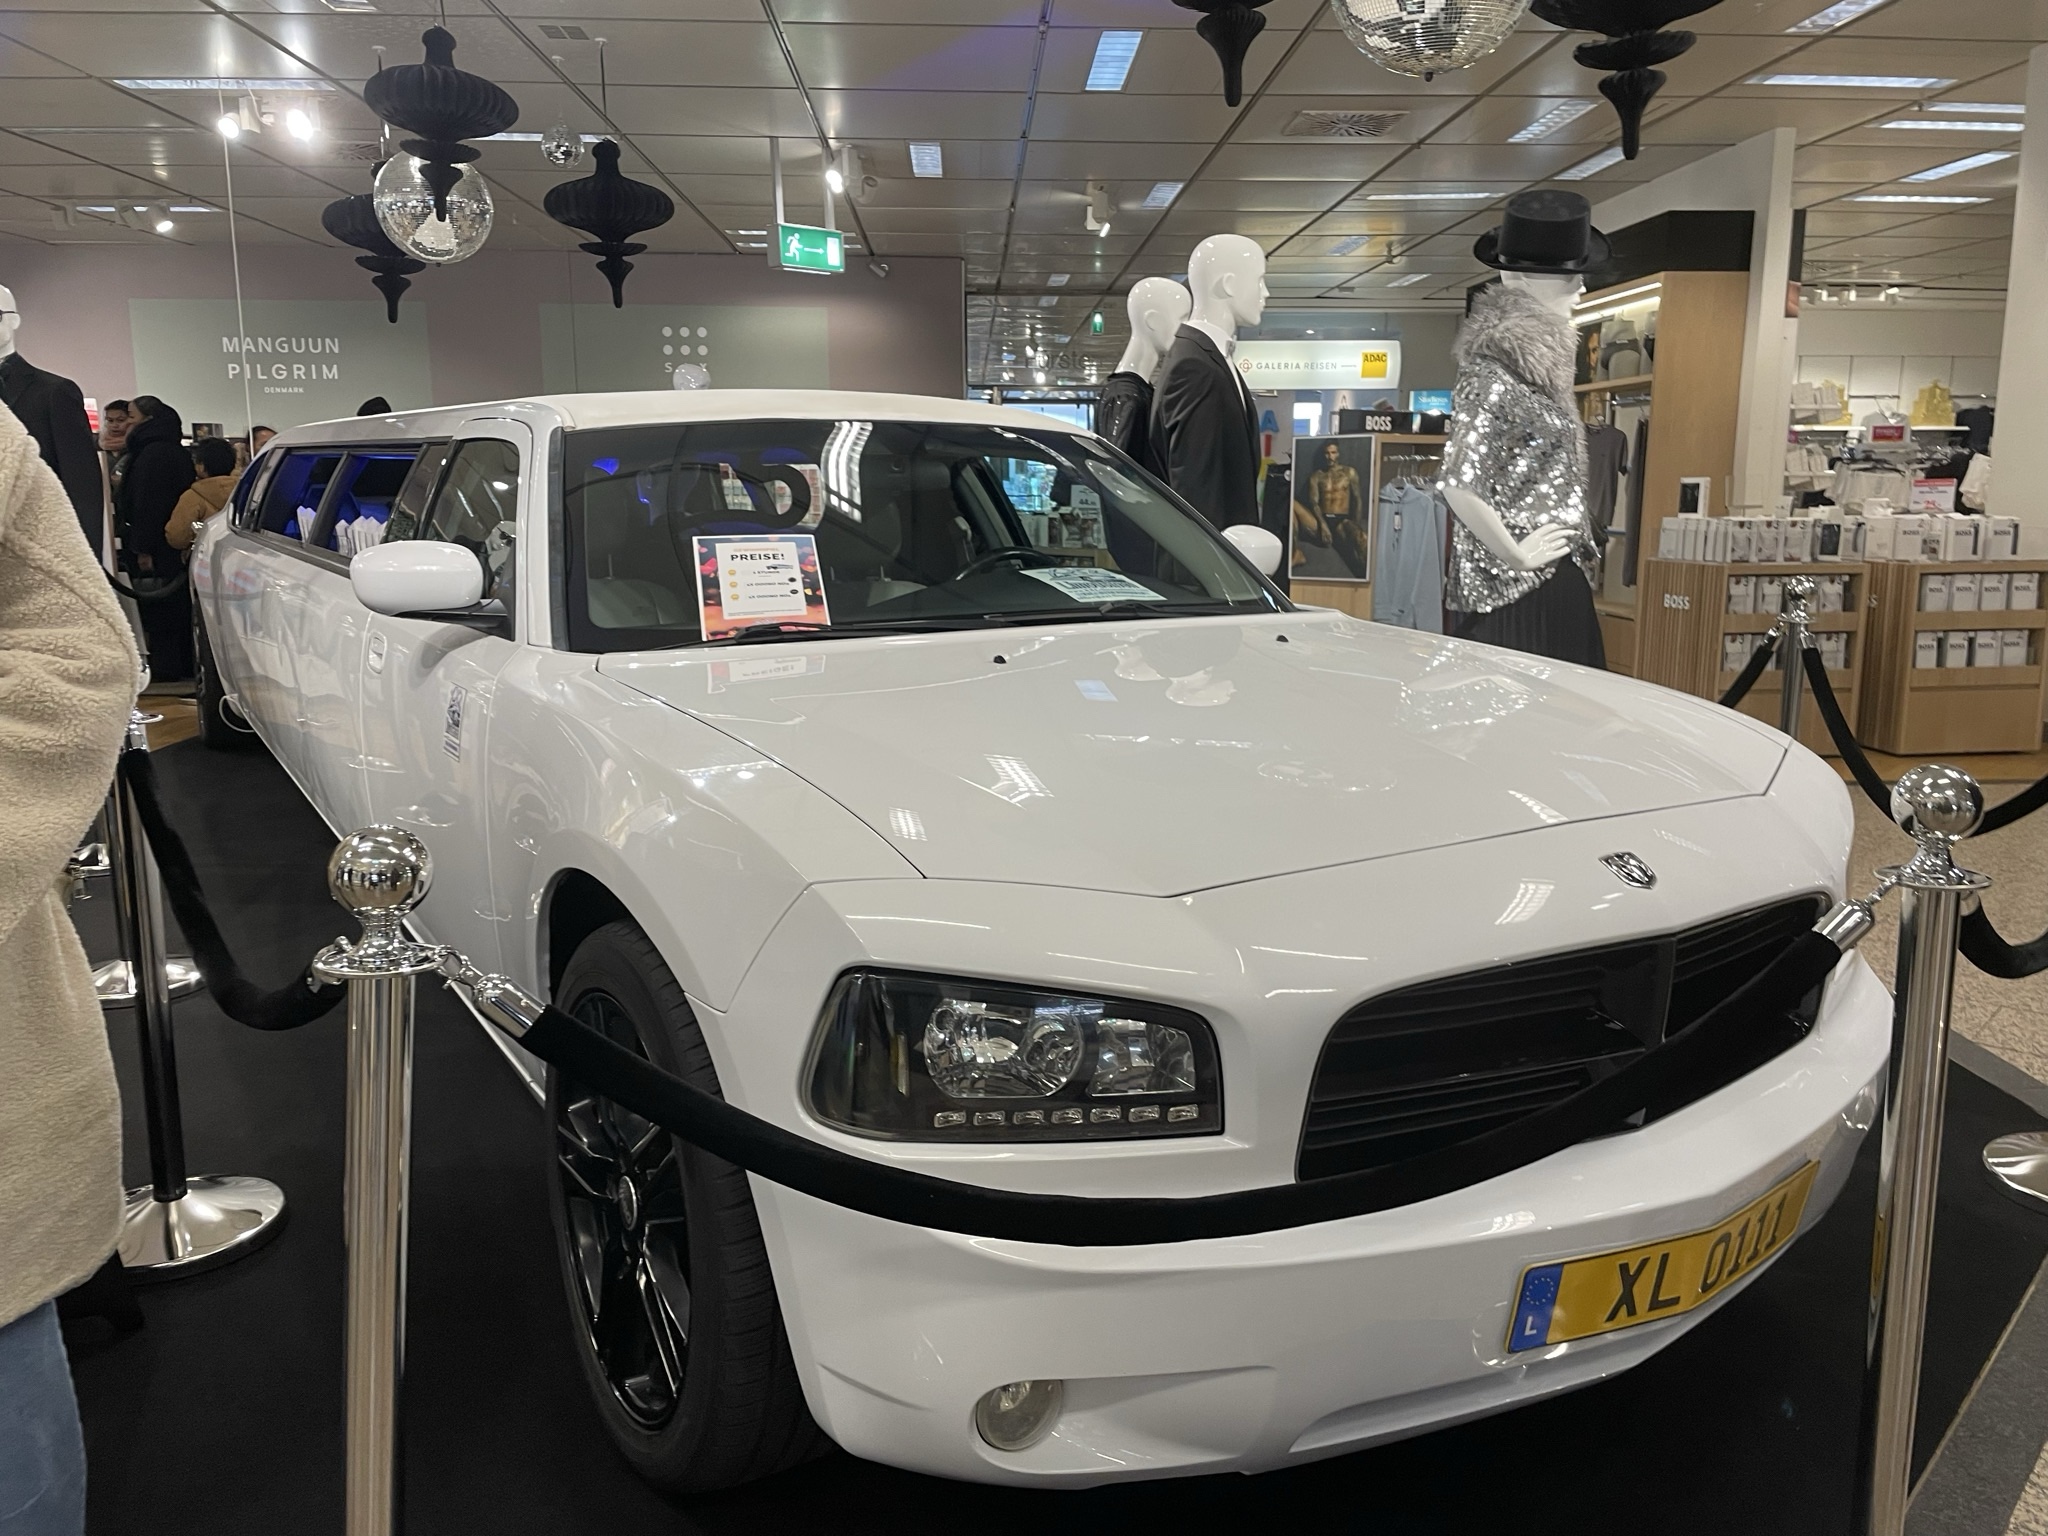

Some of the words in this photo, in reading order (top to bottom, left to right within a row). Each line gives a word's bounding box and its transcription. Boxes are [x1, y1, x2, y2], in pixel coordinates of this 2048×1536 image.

[222, 336, 339, 354] MANGUUN
[1256, 362, 1301, 370] GALERIA
[1304, 361, 1337, 370] REISEN
[1363, 353, 1388, 363] ADAC
[227, 363, 339, 380] PILGRIM
[264, 386, 305, 394] DENMARK
[1365, 415, 1392, 432] BOSS
[730, 553, 785, 561] PREISE!
[1663, 593, 1691, 610] BOSS
[1604, 1252, 1682, 1323] XL
[1700, 1192, 1788, 1294] 0111
[1524, 1316, 1537, 1336] L
